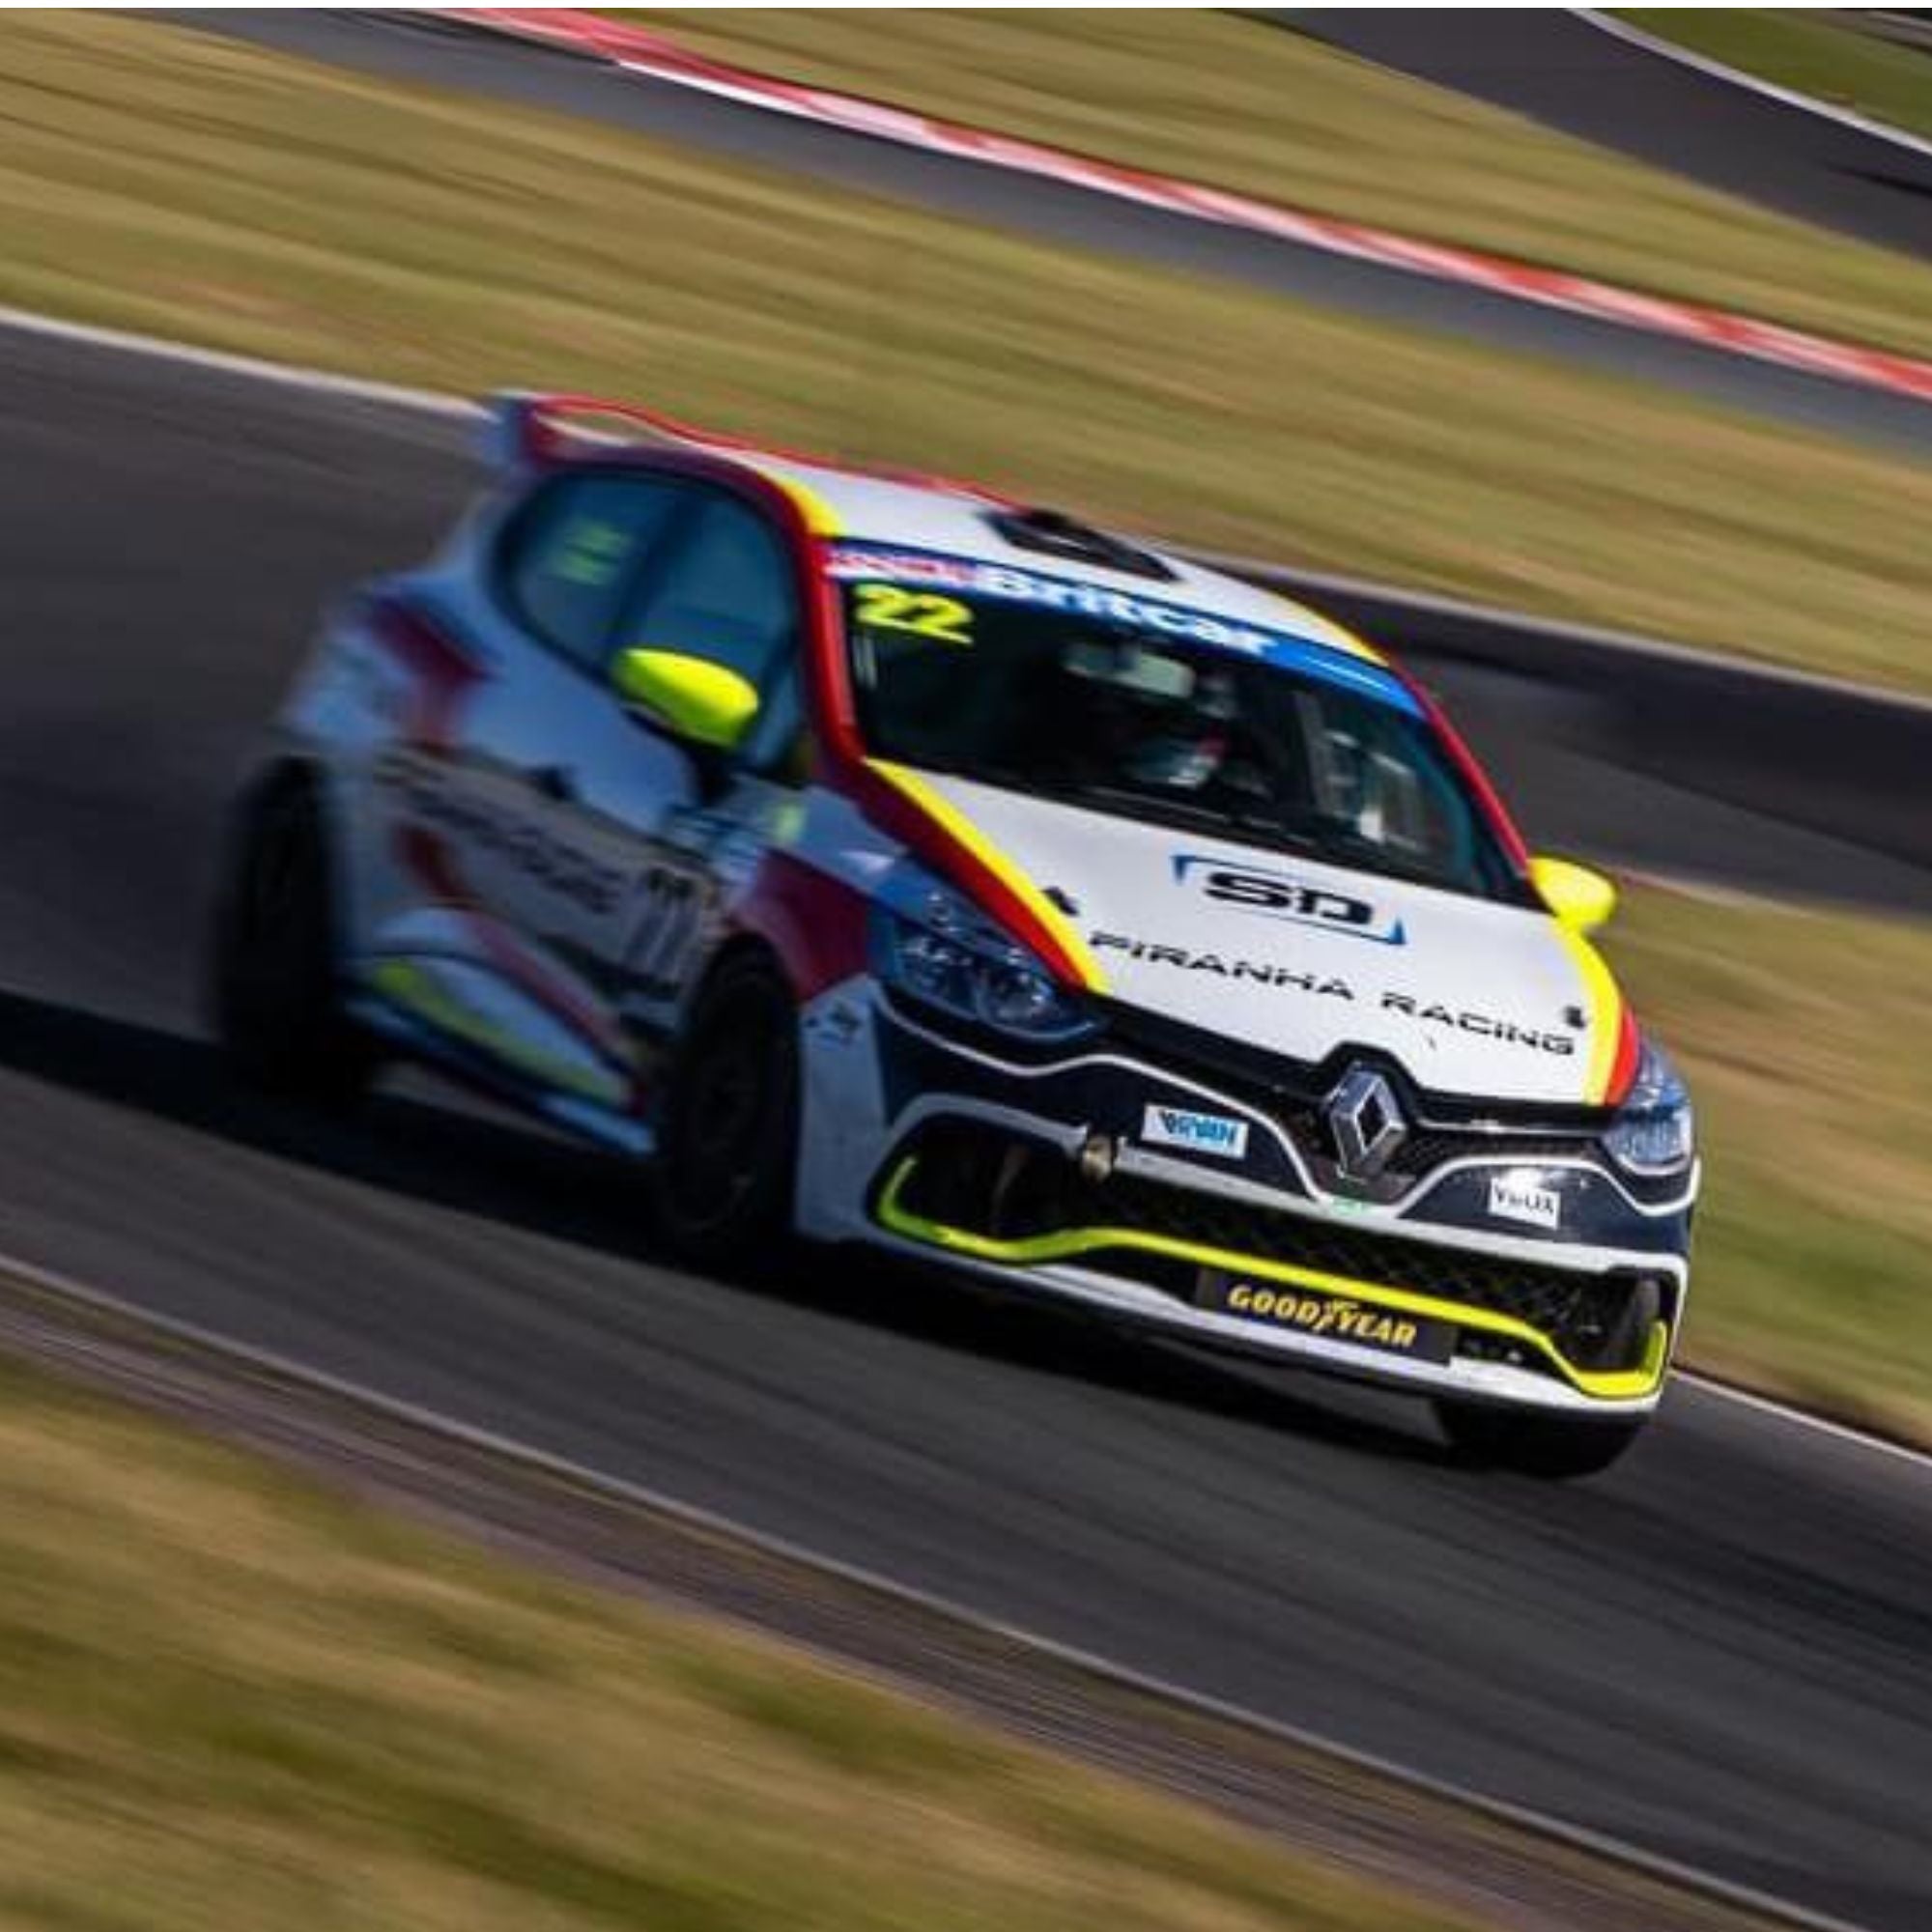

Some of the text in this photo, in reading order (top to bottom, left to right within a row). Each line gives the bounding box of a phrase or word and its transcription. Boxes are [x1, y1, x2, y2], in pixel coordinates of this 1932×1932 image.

[857, 583, 975, 643] 22
[1206, 870, 1374, 927] SD
[1089, 929, 1577, 1058] PIRANHA RACING
[1227, 1284, 1418, 1348] GOODYEAR
